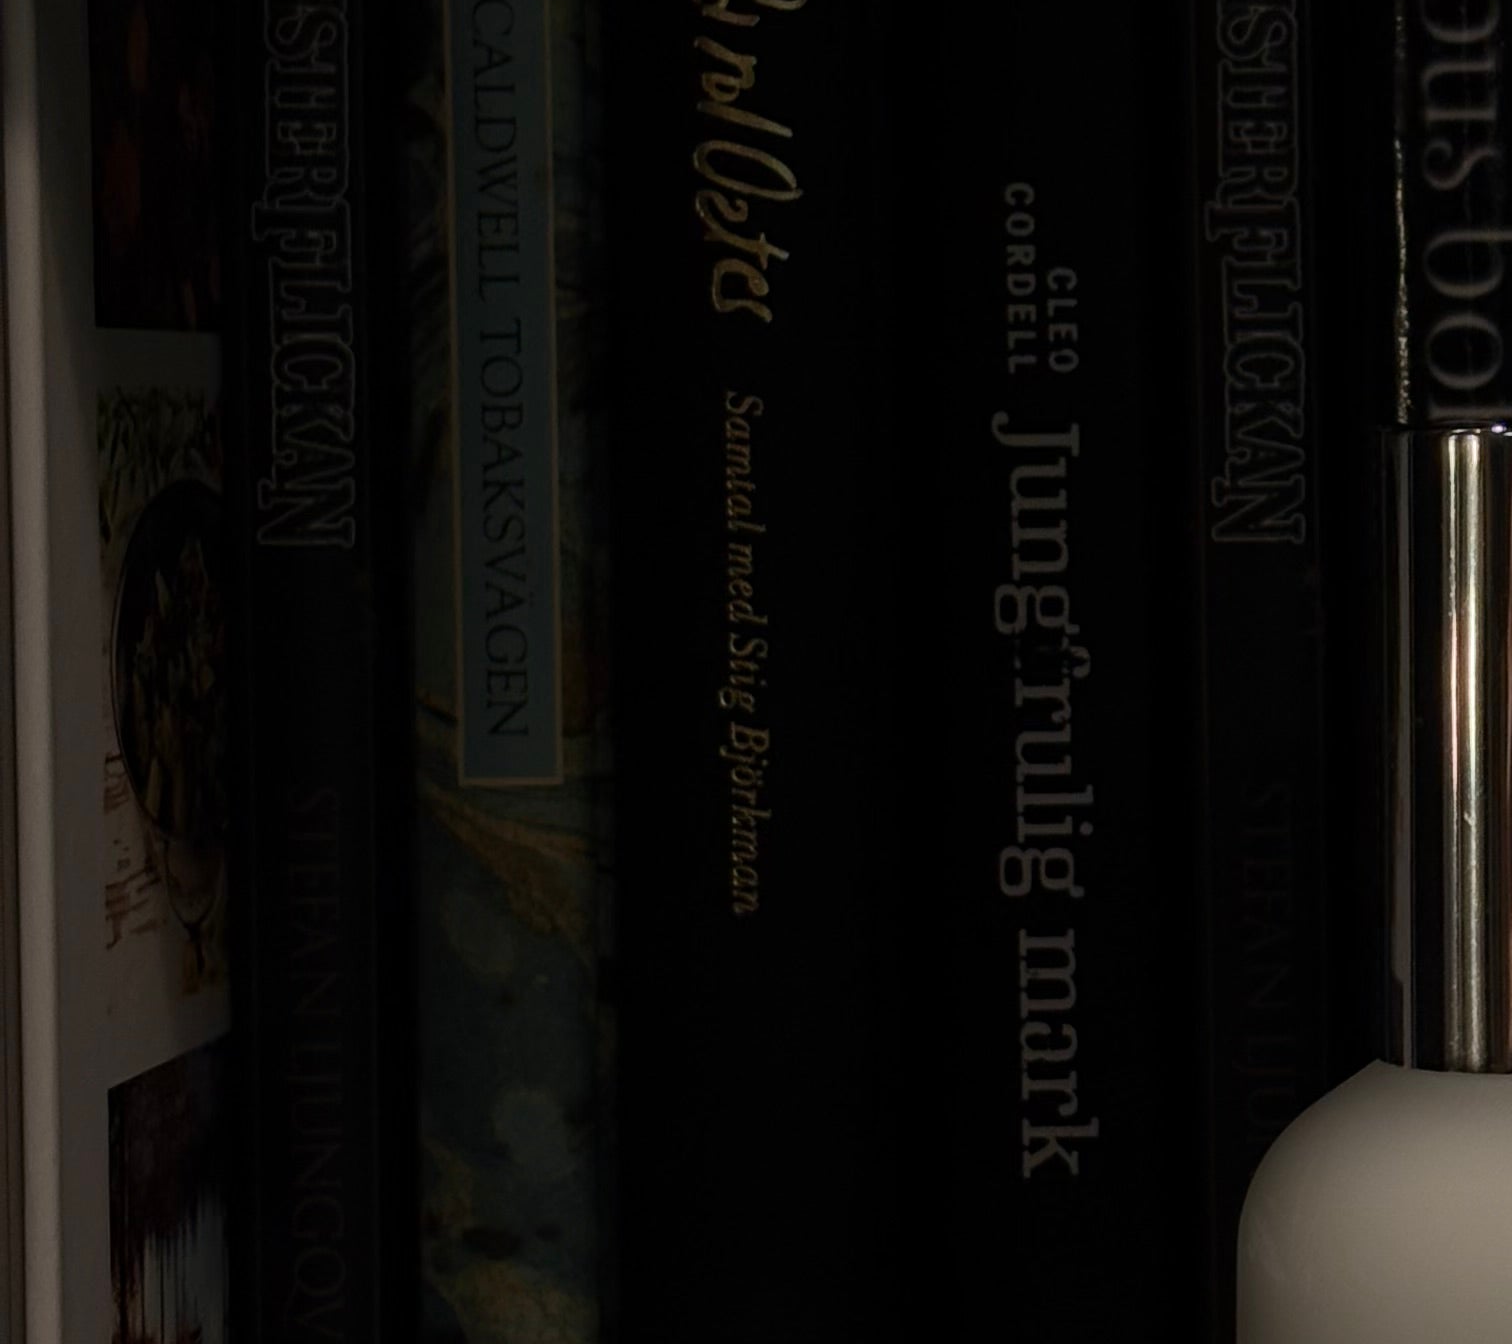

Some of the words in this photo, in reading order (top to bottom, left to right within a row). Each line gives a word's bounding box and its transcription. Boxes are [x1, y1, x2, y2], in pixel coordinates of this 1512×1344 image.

[1003, 180, 1040, 376] CORDELL
[1046, 264, 1081, 375] CLEO
[479, 320, 532, 740] TOBAKSVÄGEN
[723, 389, 768, 537] Samtal
[717, 631, 771, 714] Stig
[723, 540, 769, 627] med
[990, 408, 1095, 902] Jungfrulig
[717, 720, 772, 918] Björkman
[1016, 926, 1101, 1182] mark
